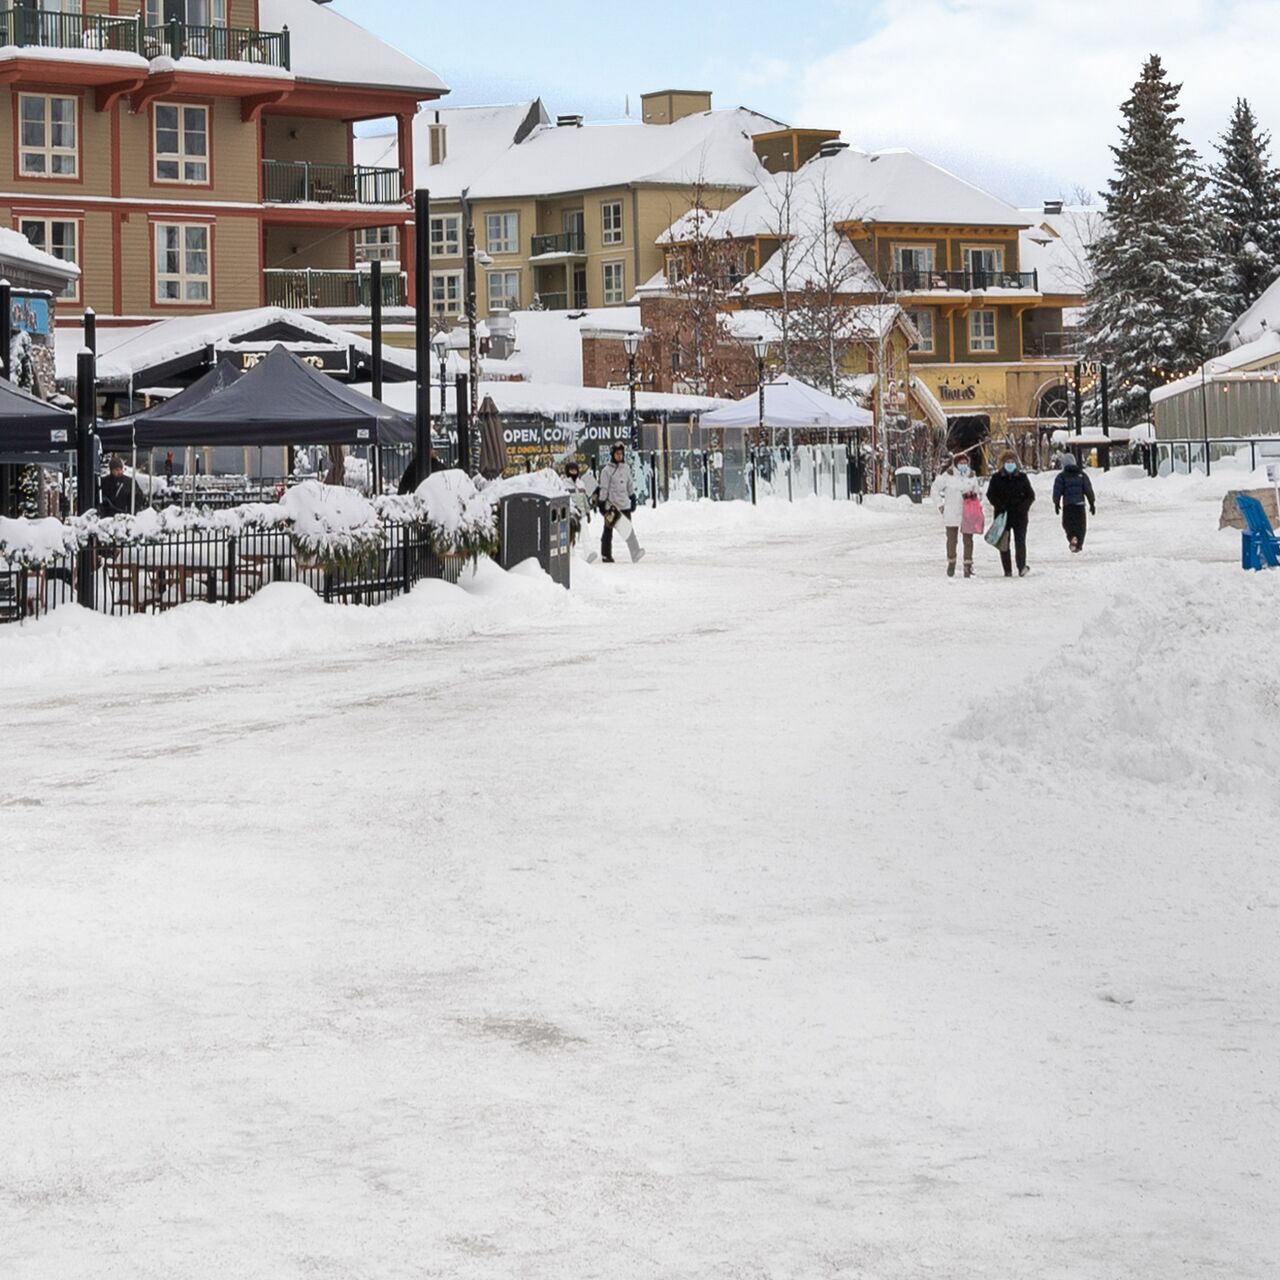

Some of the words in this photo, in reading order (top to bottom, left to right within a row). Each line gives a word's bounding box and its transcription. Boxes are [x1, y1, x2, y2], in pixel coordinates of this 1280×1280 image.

[503, 429, 541, 443] OPEN,
[583, 425, 610, 439] JOIN
[614, 425, 632, 438] US!
